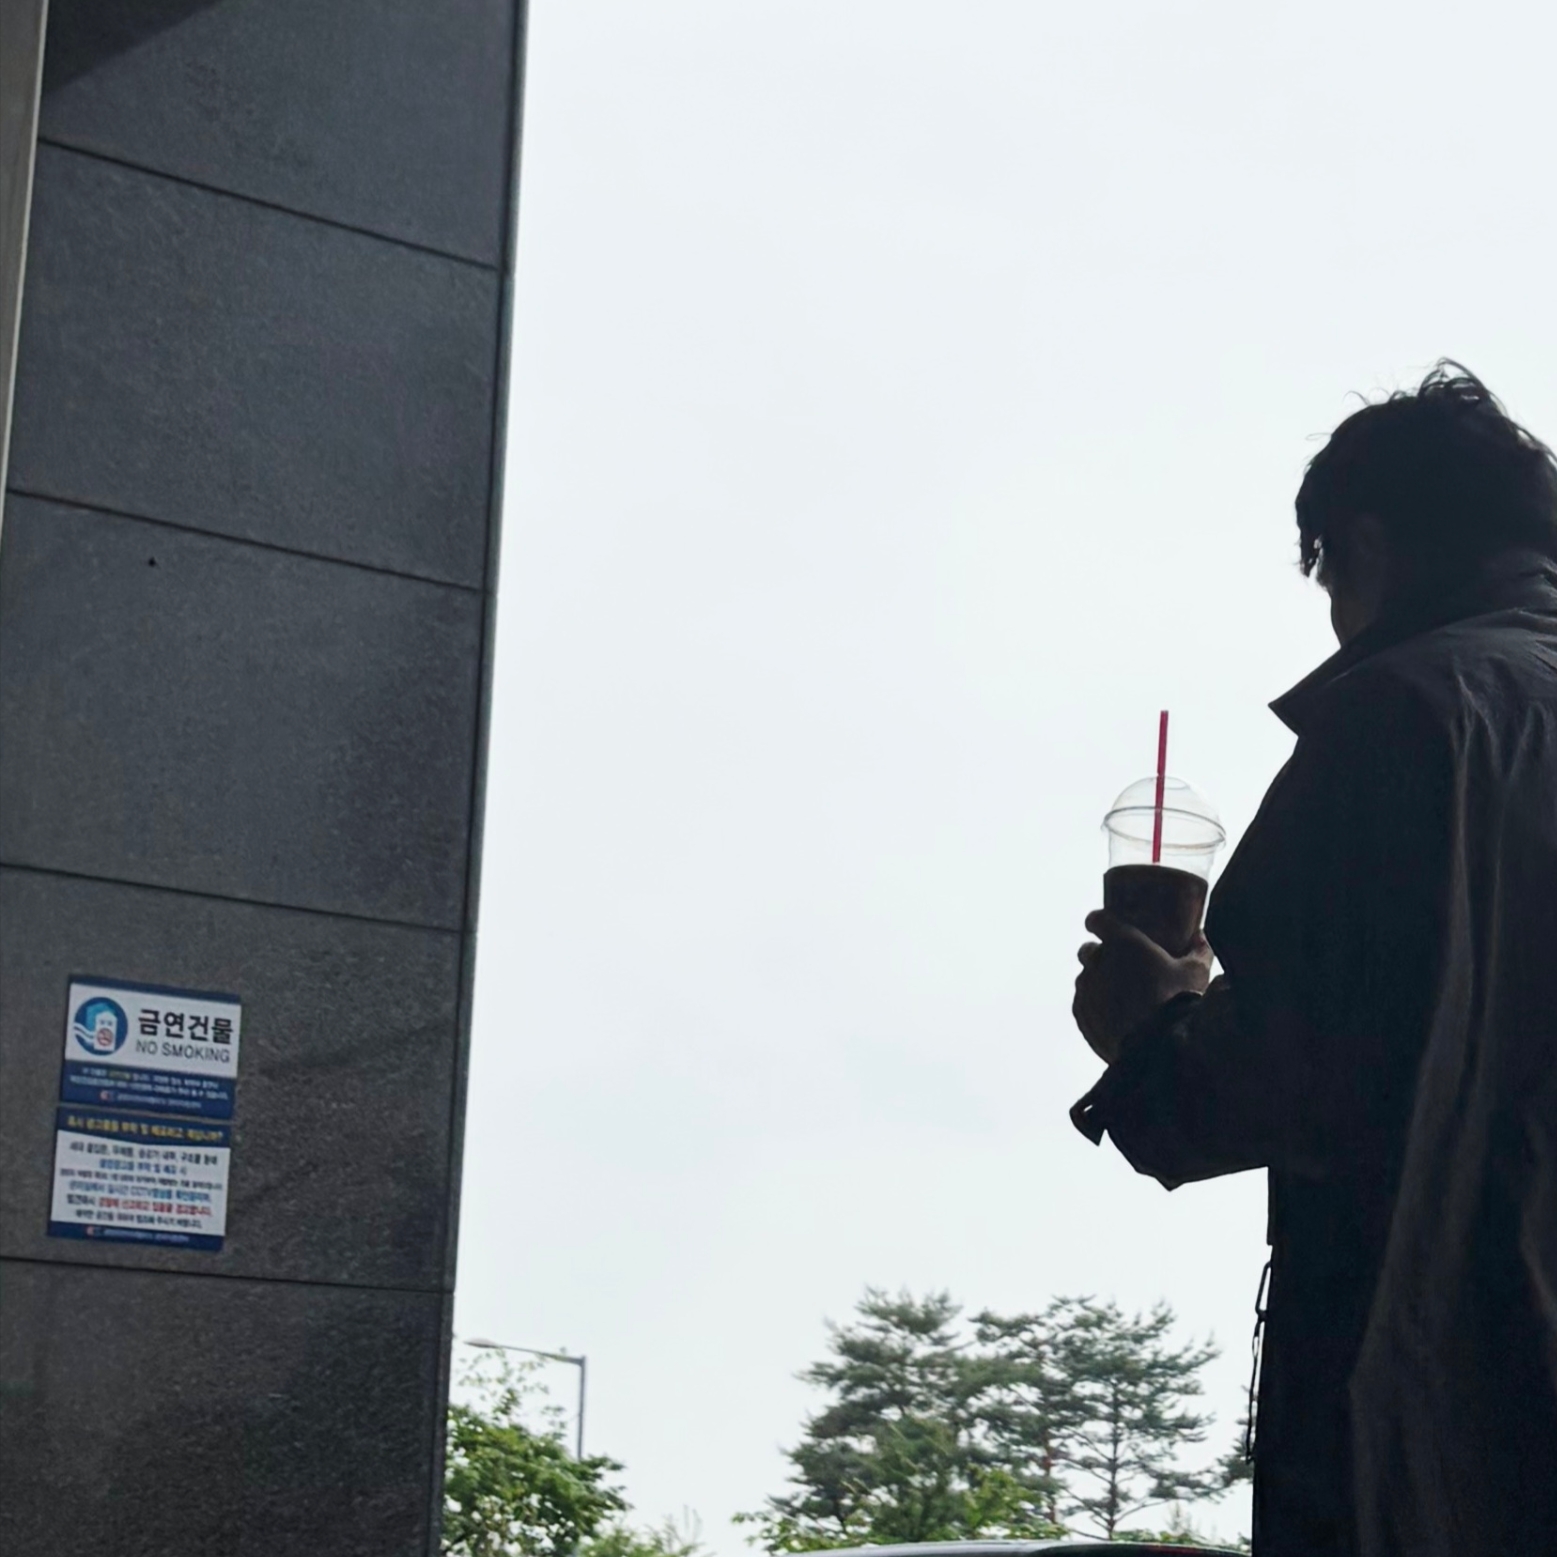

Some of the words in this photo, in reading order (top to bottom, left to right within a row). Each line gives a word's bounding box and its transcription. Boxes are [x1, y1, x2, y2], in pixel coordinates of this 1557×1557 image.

[138, 1009, 234, 1045] 금연건물
[136, 1040, 158, 1055] NO
[162, 1042, 230, 1063] SMOKING
